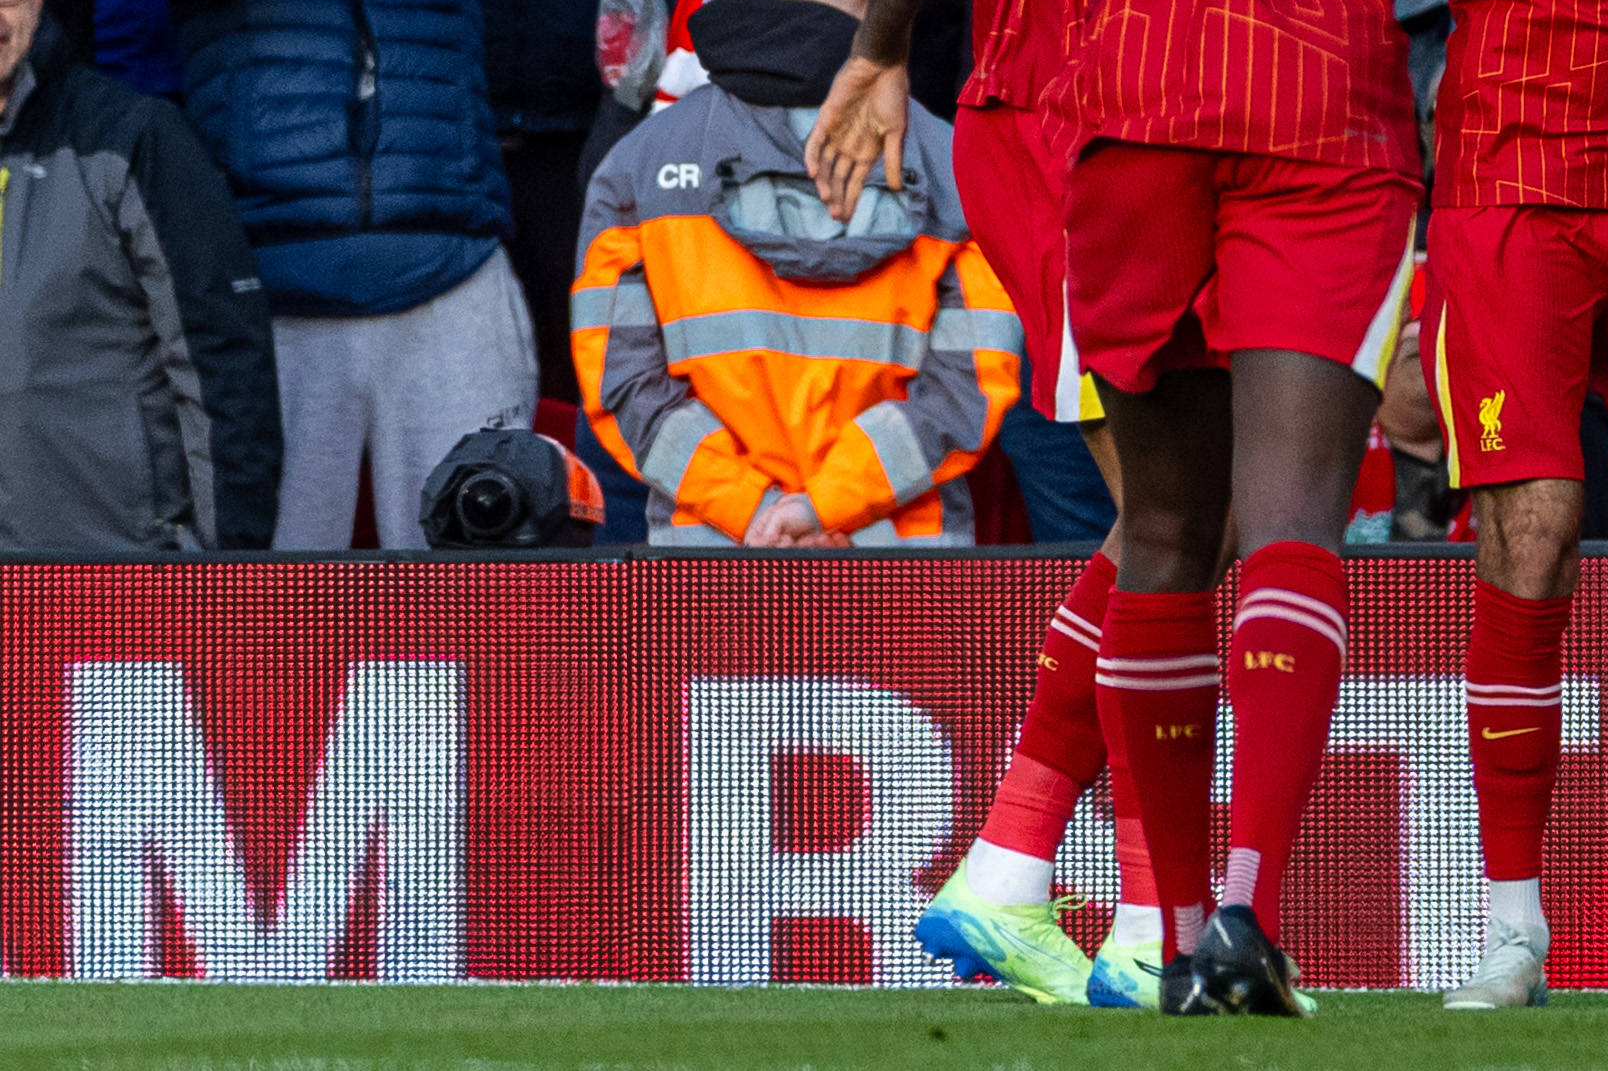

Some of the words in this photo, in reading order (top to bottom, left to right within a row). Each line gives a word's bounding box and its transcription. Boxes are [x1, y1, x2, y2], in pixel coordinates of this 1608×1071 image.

[657, 163, 701, 190] CR
[1244, 650, 1296, 673] LFC
[1155, 724, 1200, 740] LFC
